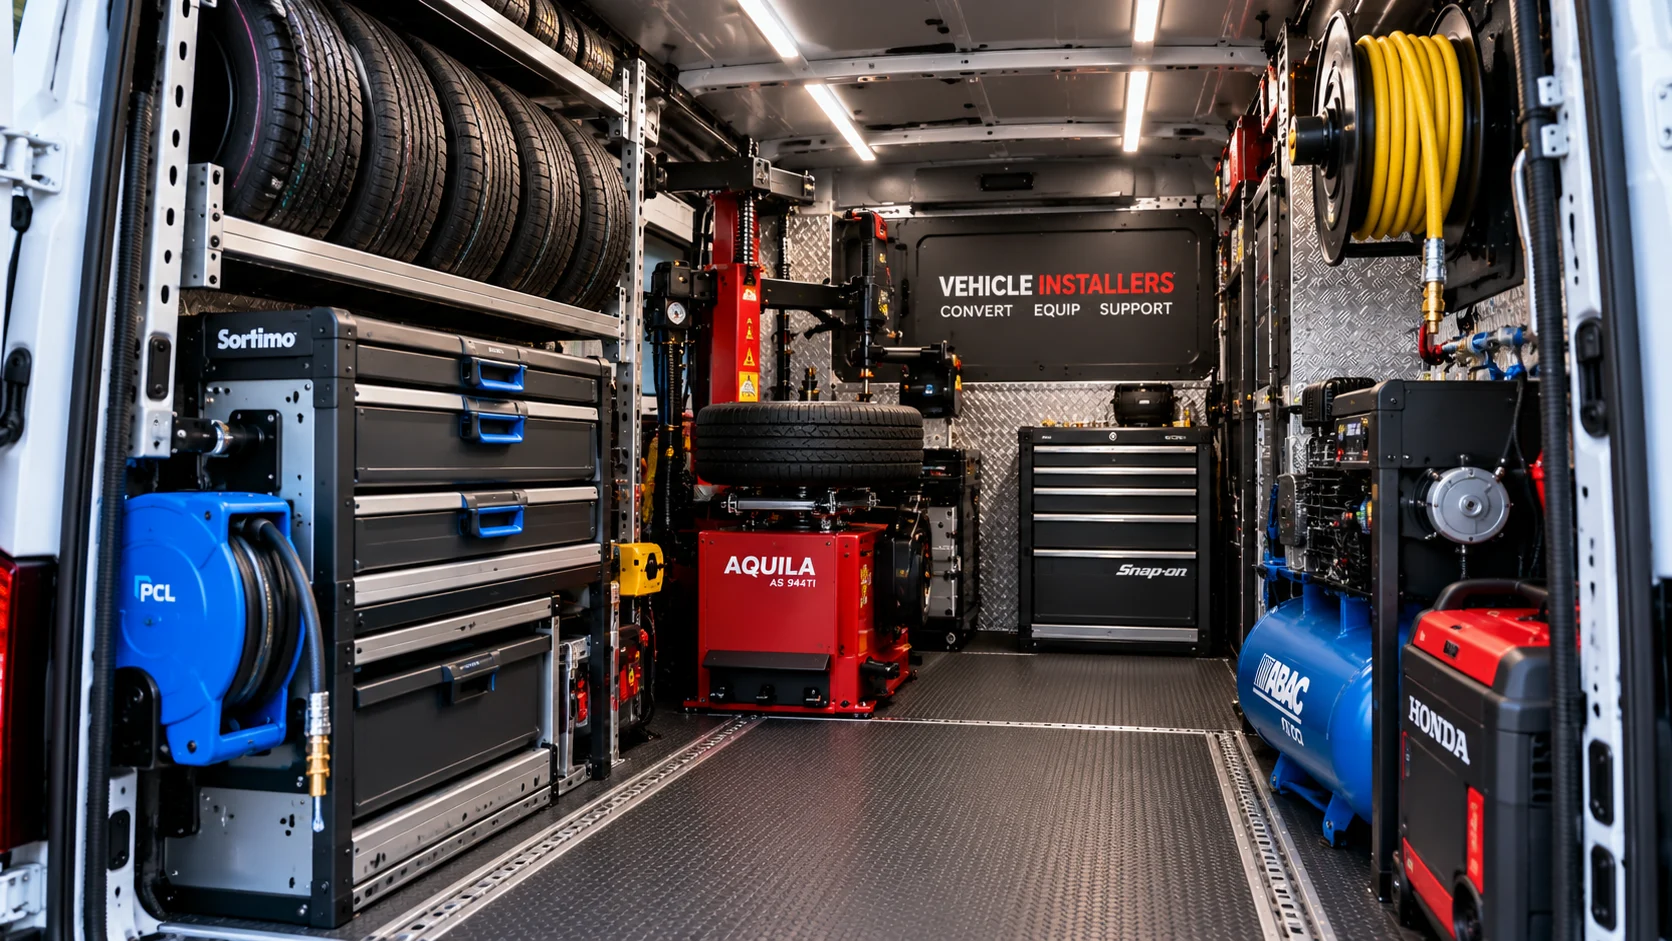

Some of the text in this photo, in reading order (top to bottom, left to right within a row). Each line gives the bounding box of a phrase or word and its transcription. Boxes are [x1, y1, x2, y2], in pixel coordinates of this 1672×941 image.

[938, 272, 1174, 297] VEHICLE INSTALLERS
[940, 301, 1173, 318] CONVERT EQUIP SUPPORT
[217, 327, 297, 350] Sortimo
[723, 555, 816, 578] AQUILA
[1115, 563, 1188, 579] Snap-on
[140, 583, 176, 602] PCL
[769, 578, 784, 587] AS
[1264, 660, 1310, 715] ABAC
[1408, 695, 1471, 766] HONDA
